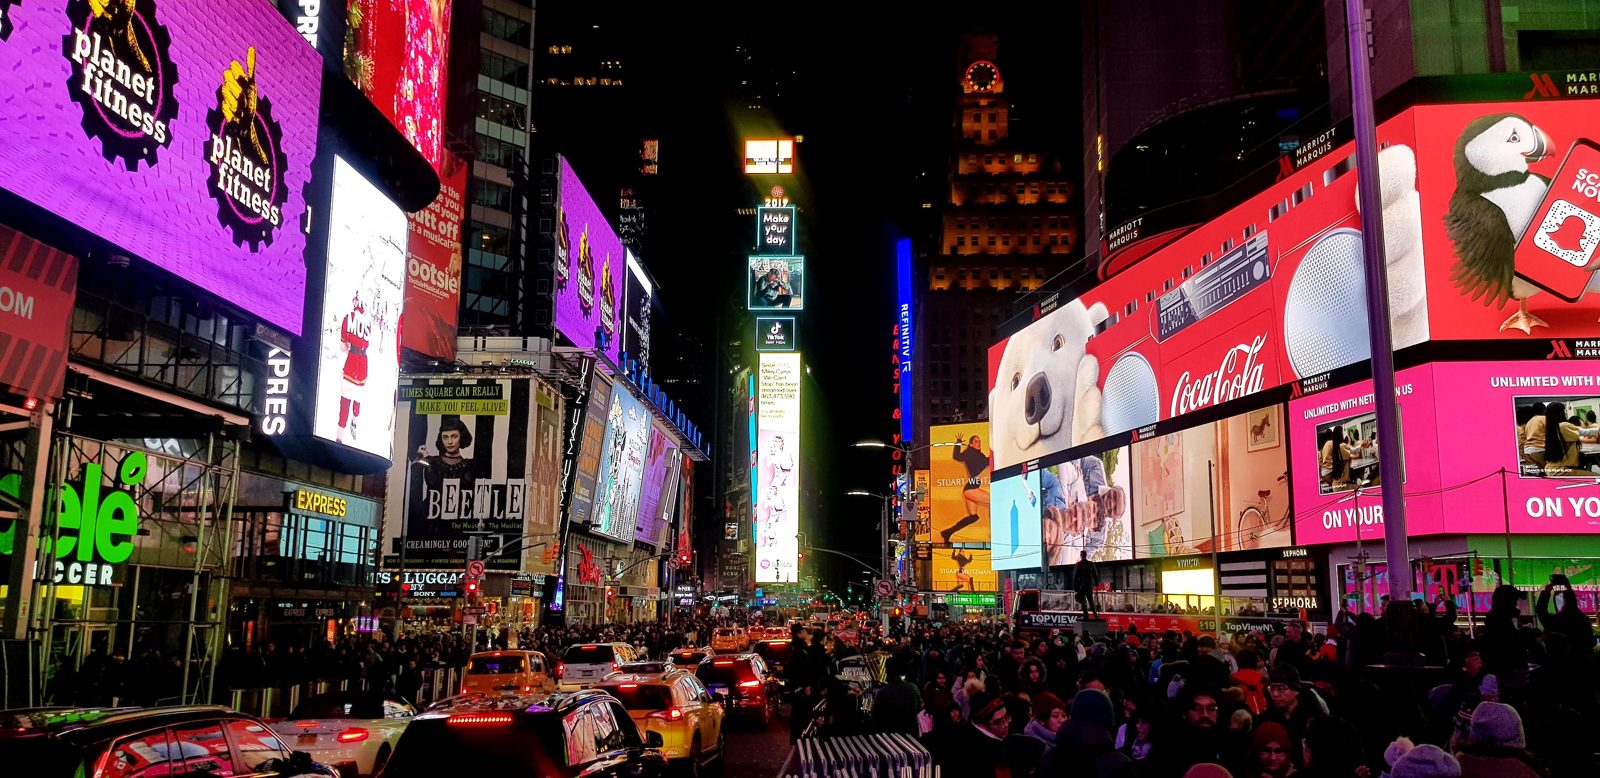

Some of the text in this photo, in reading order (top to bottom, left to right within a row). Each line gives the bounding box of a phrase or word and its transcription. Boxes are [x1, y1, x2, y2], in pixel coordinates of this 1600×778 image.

[72, 27, 156, 105] planet
[81, 66, 167, 144] fitness
[1296, 127, 1336, 157] MARRIOTT
[1297, 141, 1332, 167] MARQUIS
[210, 134, 272, 194] planet
[218, 166, 280, 226] fitness
[448, 186, 459, 200] the
[445, 197, 460, 211] you
[764, 198, 789, 207] 2019
[441, 207, 459, 223] your
[763, 213, 789, 223] Make
[438, 221, 459, 241] off
[765, 225, 787, 235] your
[1109, 218, 1143, 240] MARRIOTT
[766, 235, 786, 246] day.
[1109, 230, 1138, 251] MARQUIS
[407, 252, 459, 294] ootsie
[901, 303, 910, 357] REFINITIV
[892, 323, 900, 394] ERNST
[1170, 331, 1268, 417] Coca-Cola
[1303, 373, 1331, 386] MARRIOTT
[1304, 381, 1328, 394] MARQUIS
[1490, 376, 1559, 388] UNLIMITED
[1561, 375, 1594, 387] WITH
[401, 386, 500, 398] TIMES SQUARE CAN REALLY
[419, 402, 506, 412] MAKE YOU FEEL ALIVE!
[1304, 402, 1339, 419] UNLIMITED
[1340, 397, 1358, 411] WITH
[1402, 384, 1413, 395] US
[892, 408, 901, 419] &
[937, 478, 964, 486] STUART
[297, 490, 347, 517] EXPRESS
[426, 479, 524, 520] BEETLE
[1526, 496, 1563, 518] ON
[1323, 510, 1342, 529] ON
[453, 539, 471, 549] GOO
[1282, 548, 1308, 557] SEPHORA
[1176, 558, 1200, 568] INVICTA
[403, 572, 466, 584] LUGGA
[1272, 597, 1318, 609] SEPHORA
[284, 608, 306, 617] EXPRESS
[315, 608, 335, 617] EXPRESS
[1030, 614, 1078, 624] TOPVIEW
